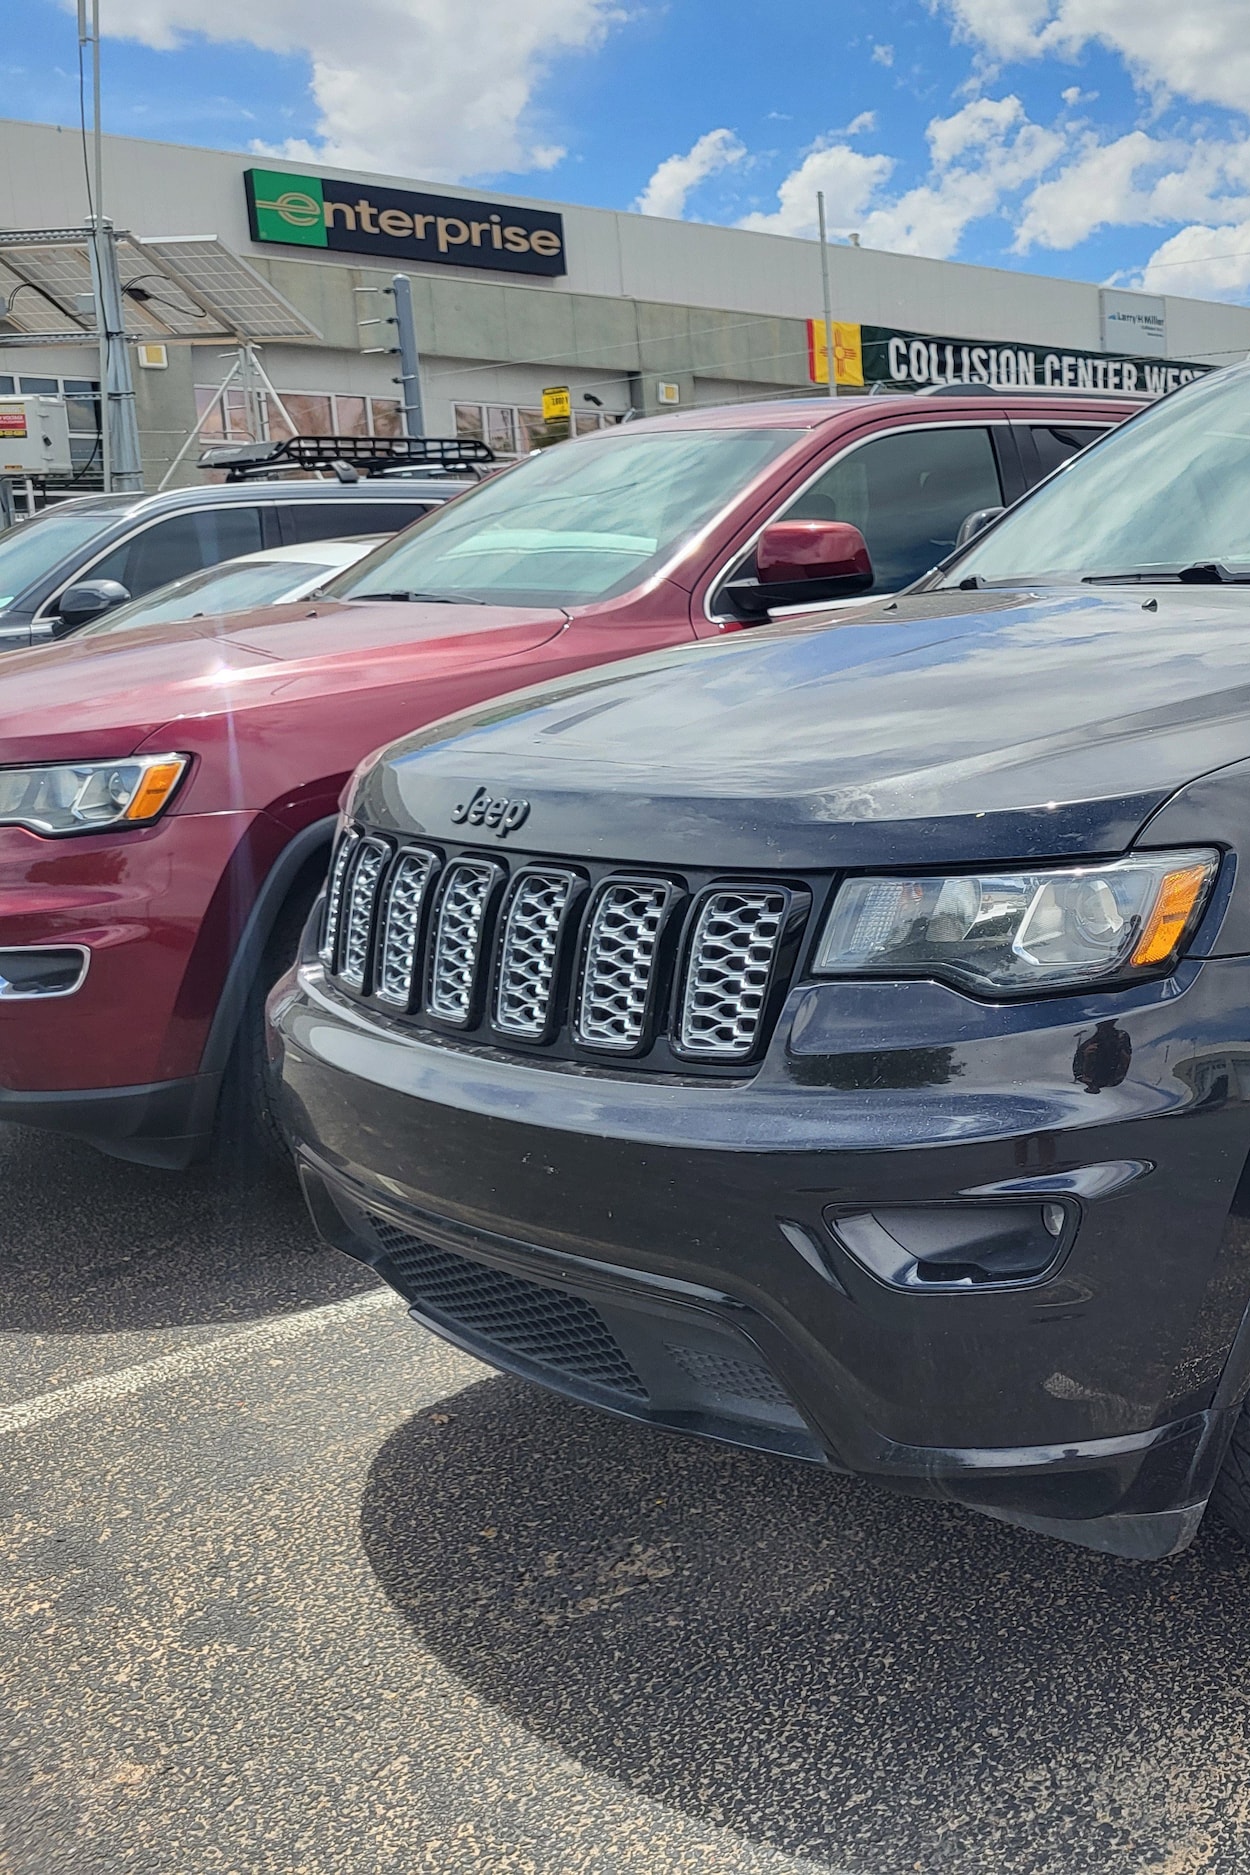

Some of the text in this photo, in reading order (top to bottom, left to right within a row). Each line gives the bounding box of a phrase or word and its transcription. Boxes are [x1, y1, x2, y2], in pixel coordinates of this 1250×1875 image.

[255, 192, 561, 256] enterprise
[1116, 312, 1136, 325] Larry
[888, 337, 1036, 386] COLLISION
[1044, 354, 1138, 392] CENTER
[451, 786, 531, 839] Jeep
